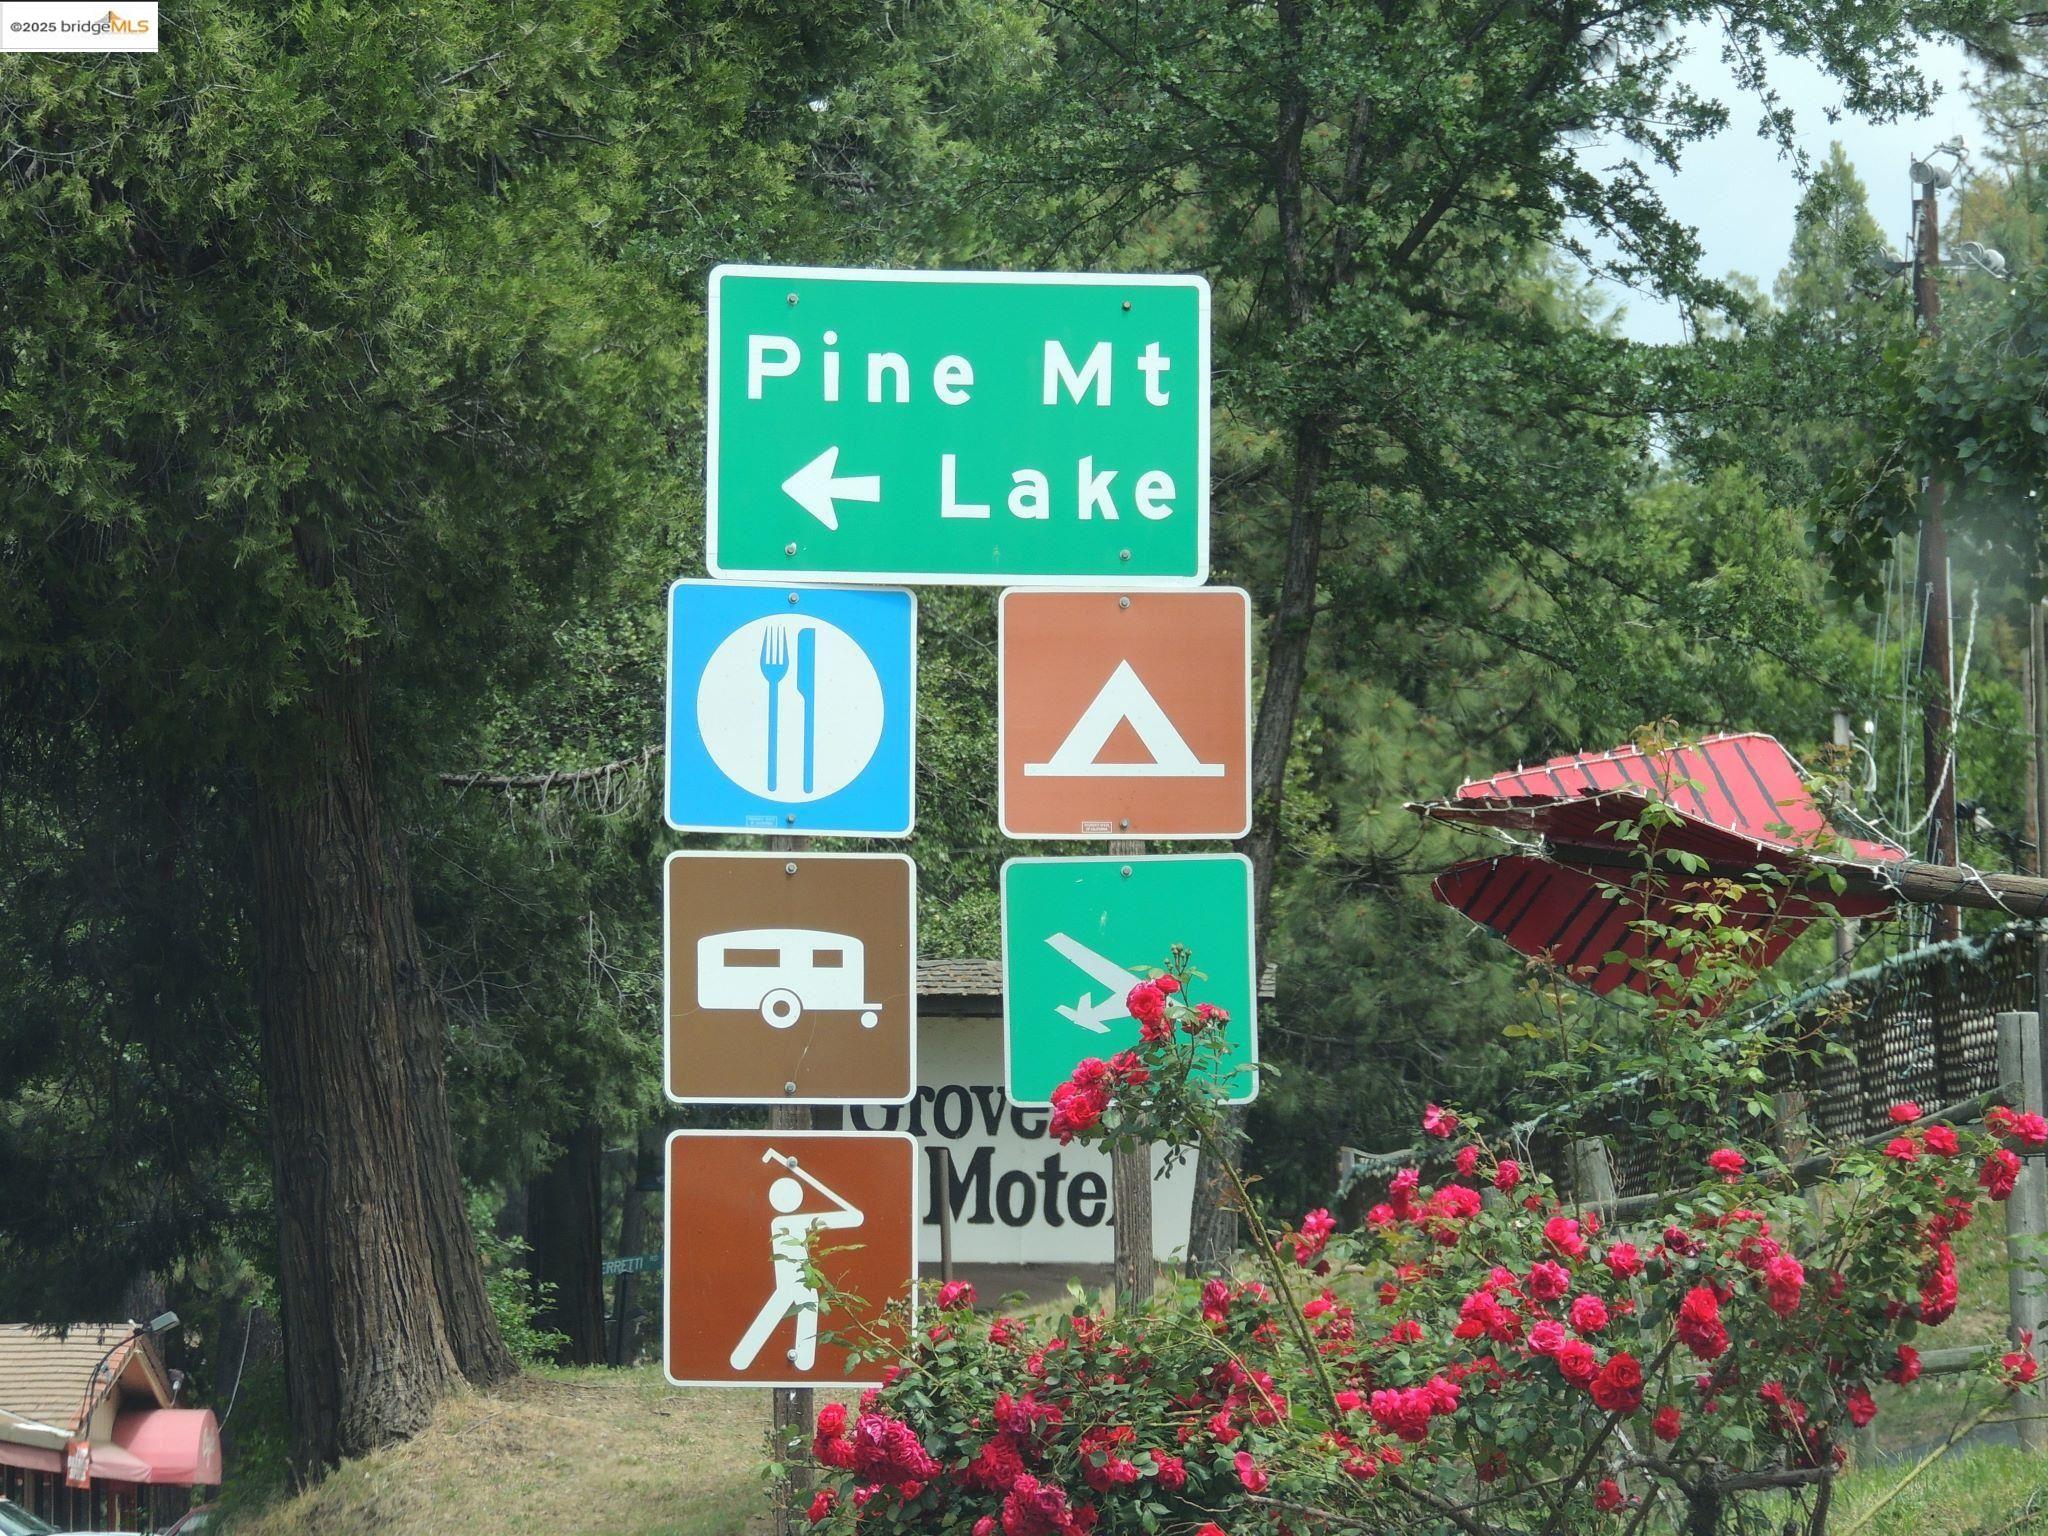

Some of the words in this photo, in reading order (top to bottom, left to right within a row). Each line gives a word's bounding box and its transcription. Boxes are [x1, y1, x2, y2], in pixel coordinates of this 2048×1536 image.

[747, 330, 975, 406] Pine
[1043, 340, 1171, 407] Mt
[941, 454, 1177, 520] Lake
[922, 1146, 1115, 1228] Mote
[602, 1257, 643, 1275] ERRETTI
